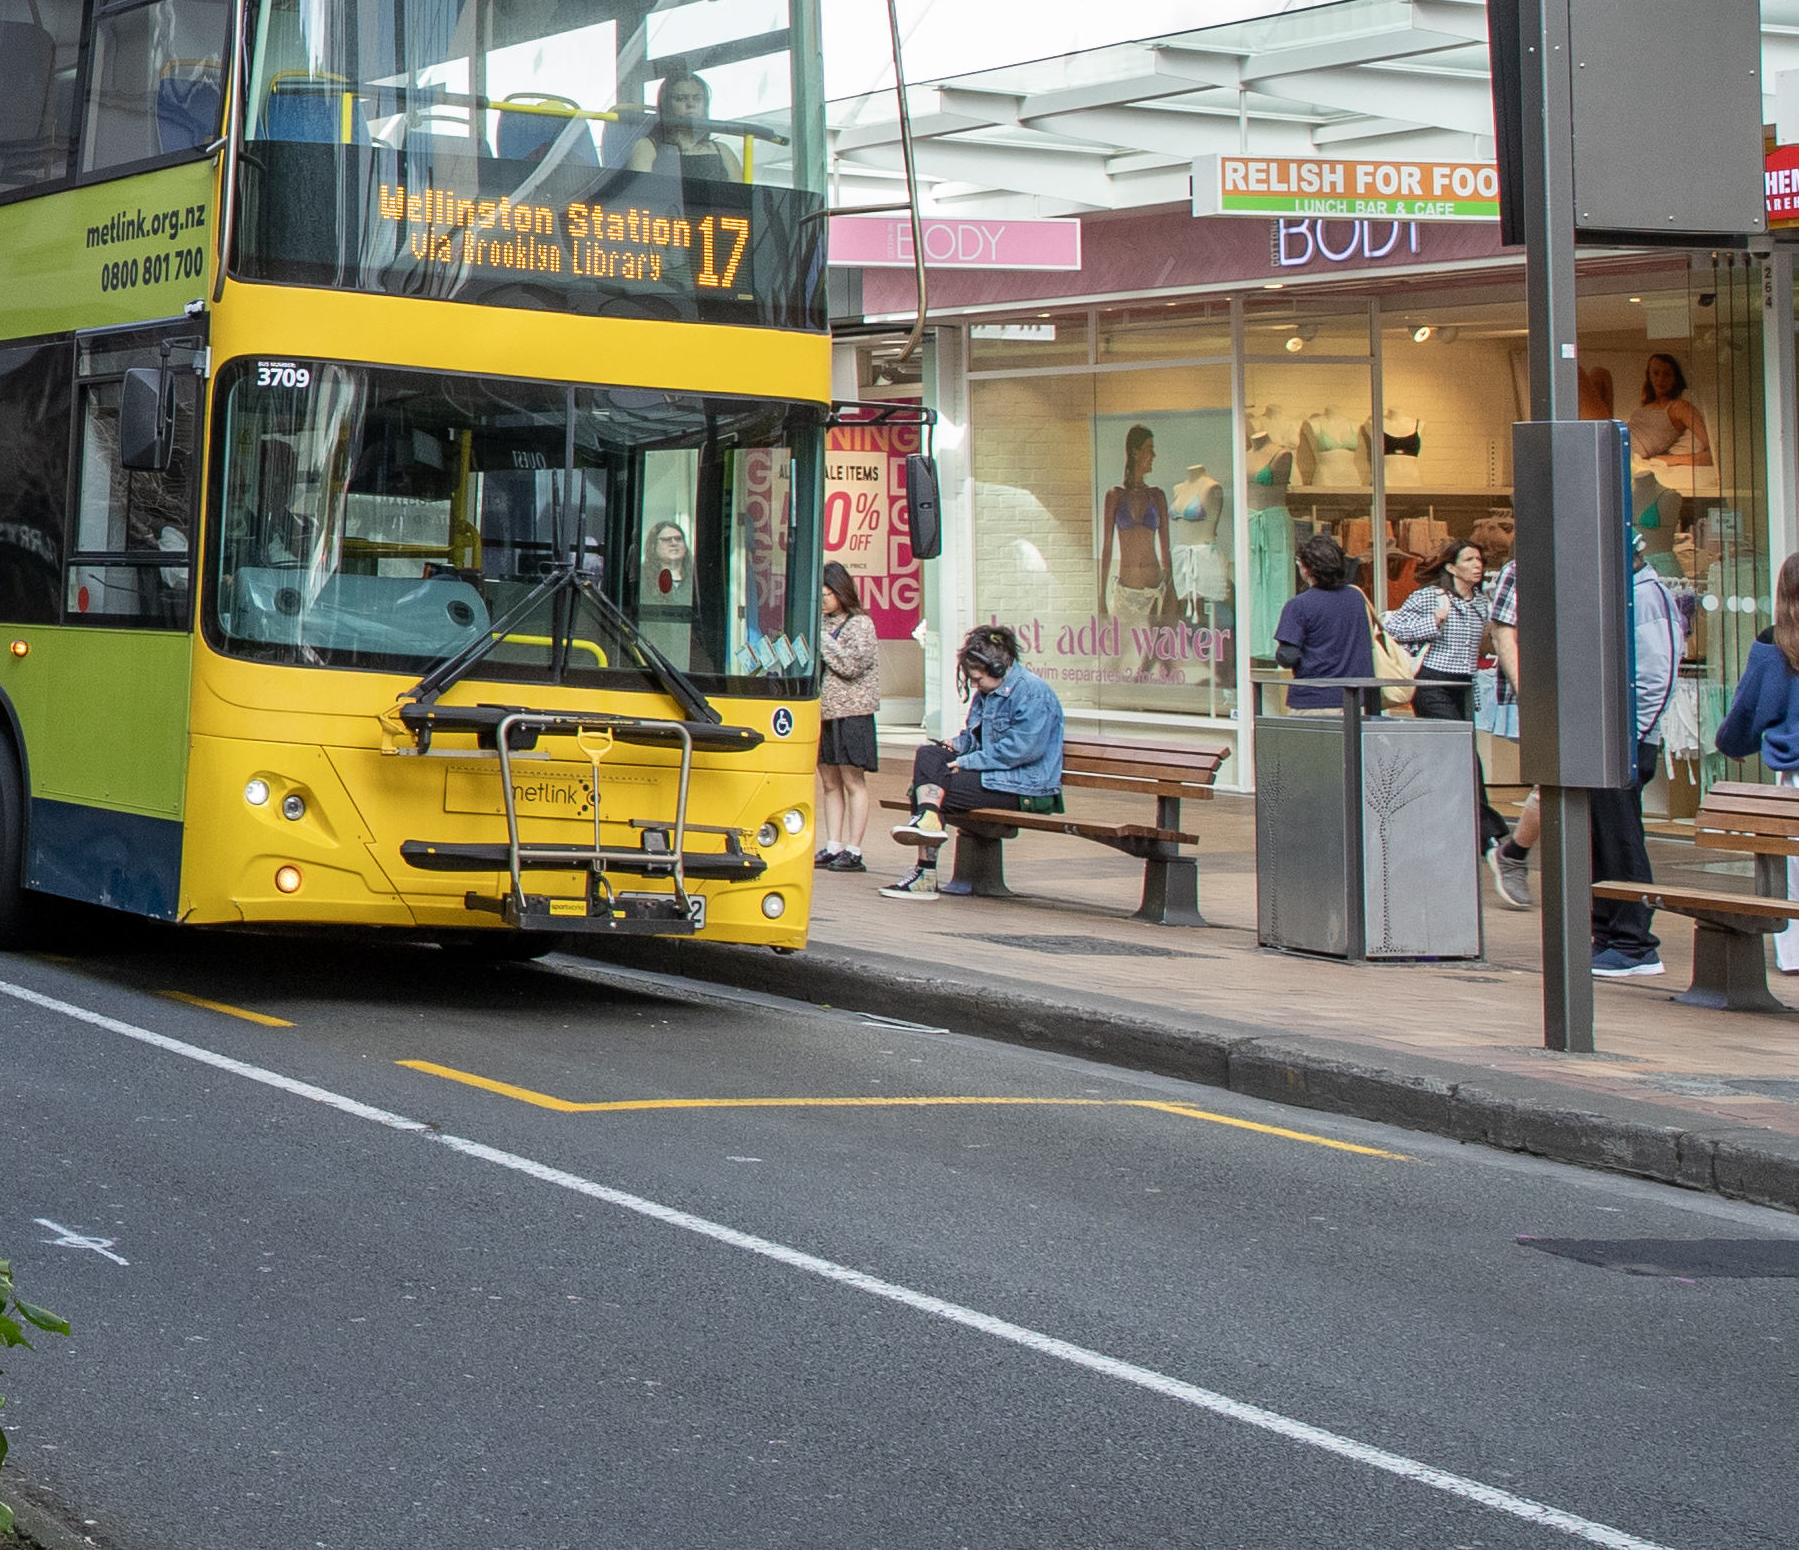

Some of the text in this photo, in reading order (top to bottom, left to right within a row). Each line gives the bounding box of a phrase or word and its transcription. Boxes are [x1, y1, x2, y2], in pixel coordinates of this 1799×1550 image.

[1225, 161, 1499, 198] RELISH FOR FOO
[86, 204, 205, 248] metlink.org.nz
[1295, 199, 1455, 216] LUNCH BAR & CAFE
[381, 184, 749, 288] Wellington Station 17
[411, 226, 661, 281] via Brooklyn Library
[897, 222, 1005, 261] BODY
[101, 246, 203, 292] 0800 801 700
[256, 367, 310, 388] 3709
[846, 465, 879, 481] ITEMS
[849, 534, 873, 551] OFF
[1057, 615, 1120, 657] add
[1131, 619, 1231, 662] water
[1025, 661, 1059, 681] Swim
[1062, 666, 1121, 685] separates
[1126, 667, 1134, 684] 2
[512, 783, 578, 805] metlink
